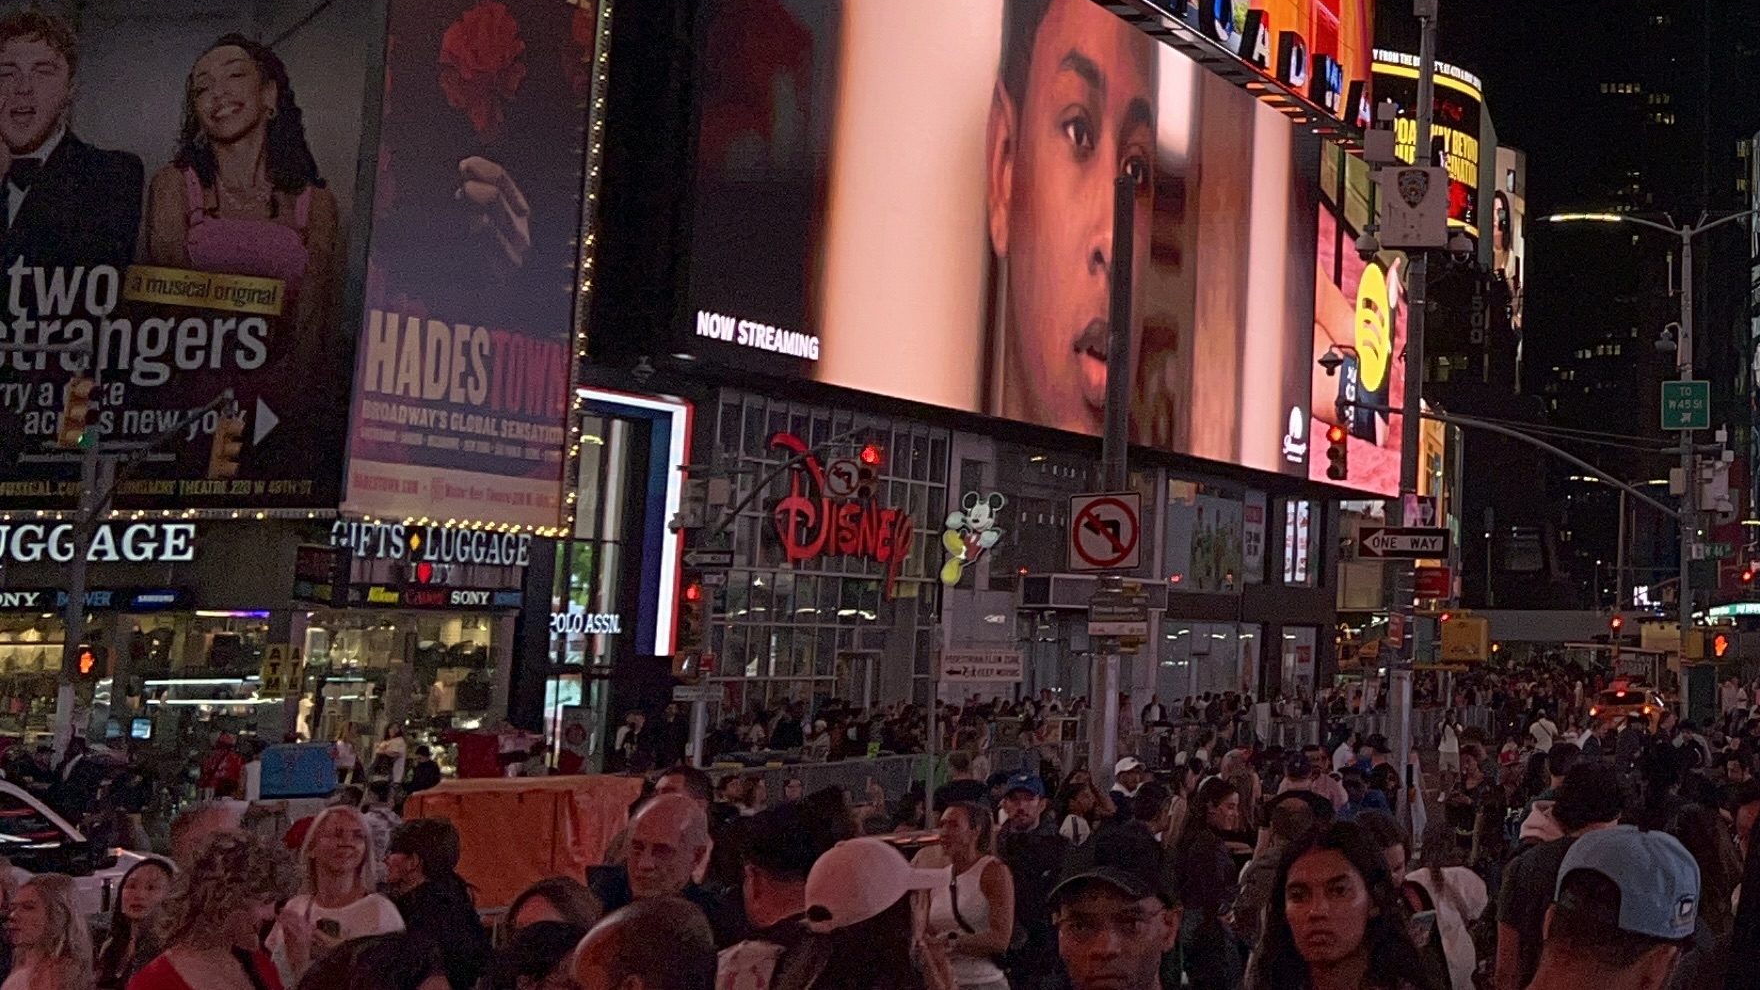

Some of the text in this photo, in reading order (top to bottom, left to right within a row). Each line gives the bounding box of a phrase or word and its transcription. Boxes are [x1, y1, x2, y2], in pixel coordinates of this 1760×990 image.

[8, 254, 119, 317] two
[131, 274, 278, 307] a musical original
[696, 310, 819, 360] NOW STREAMING
[365, 310, 570, 416] HADESTOWN
[1669, 399, 1692, 409] W 45
[1680, 387, 1692, 396] TO
[363, 400, 448, 429] BROADWAY'S
[451, 412, 498, 436] GLOBAL
[502, 420, 564, 445] SENSATION
[331, 521, 531, 566] GIFTS LUGGAGE
[1372, 537, 1438, 550] ONE WAY
[451, 591, 490, 605] SONY
[585, 613, 622, 635] ASSN.
